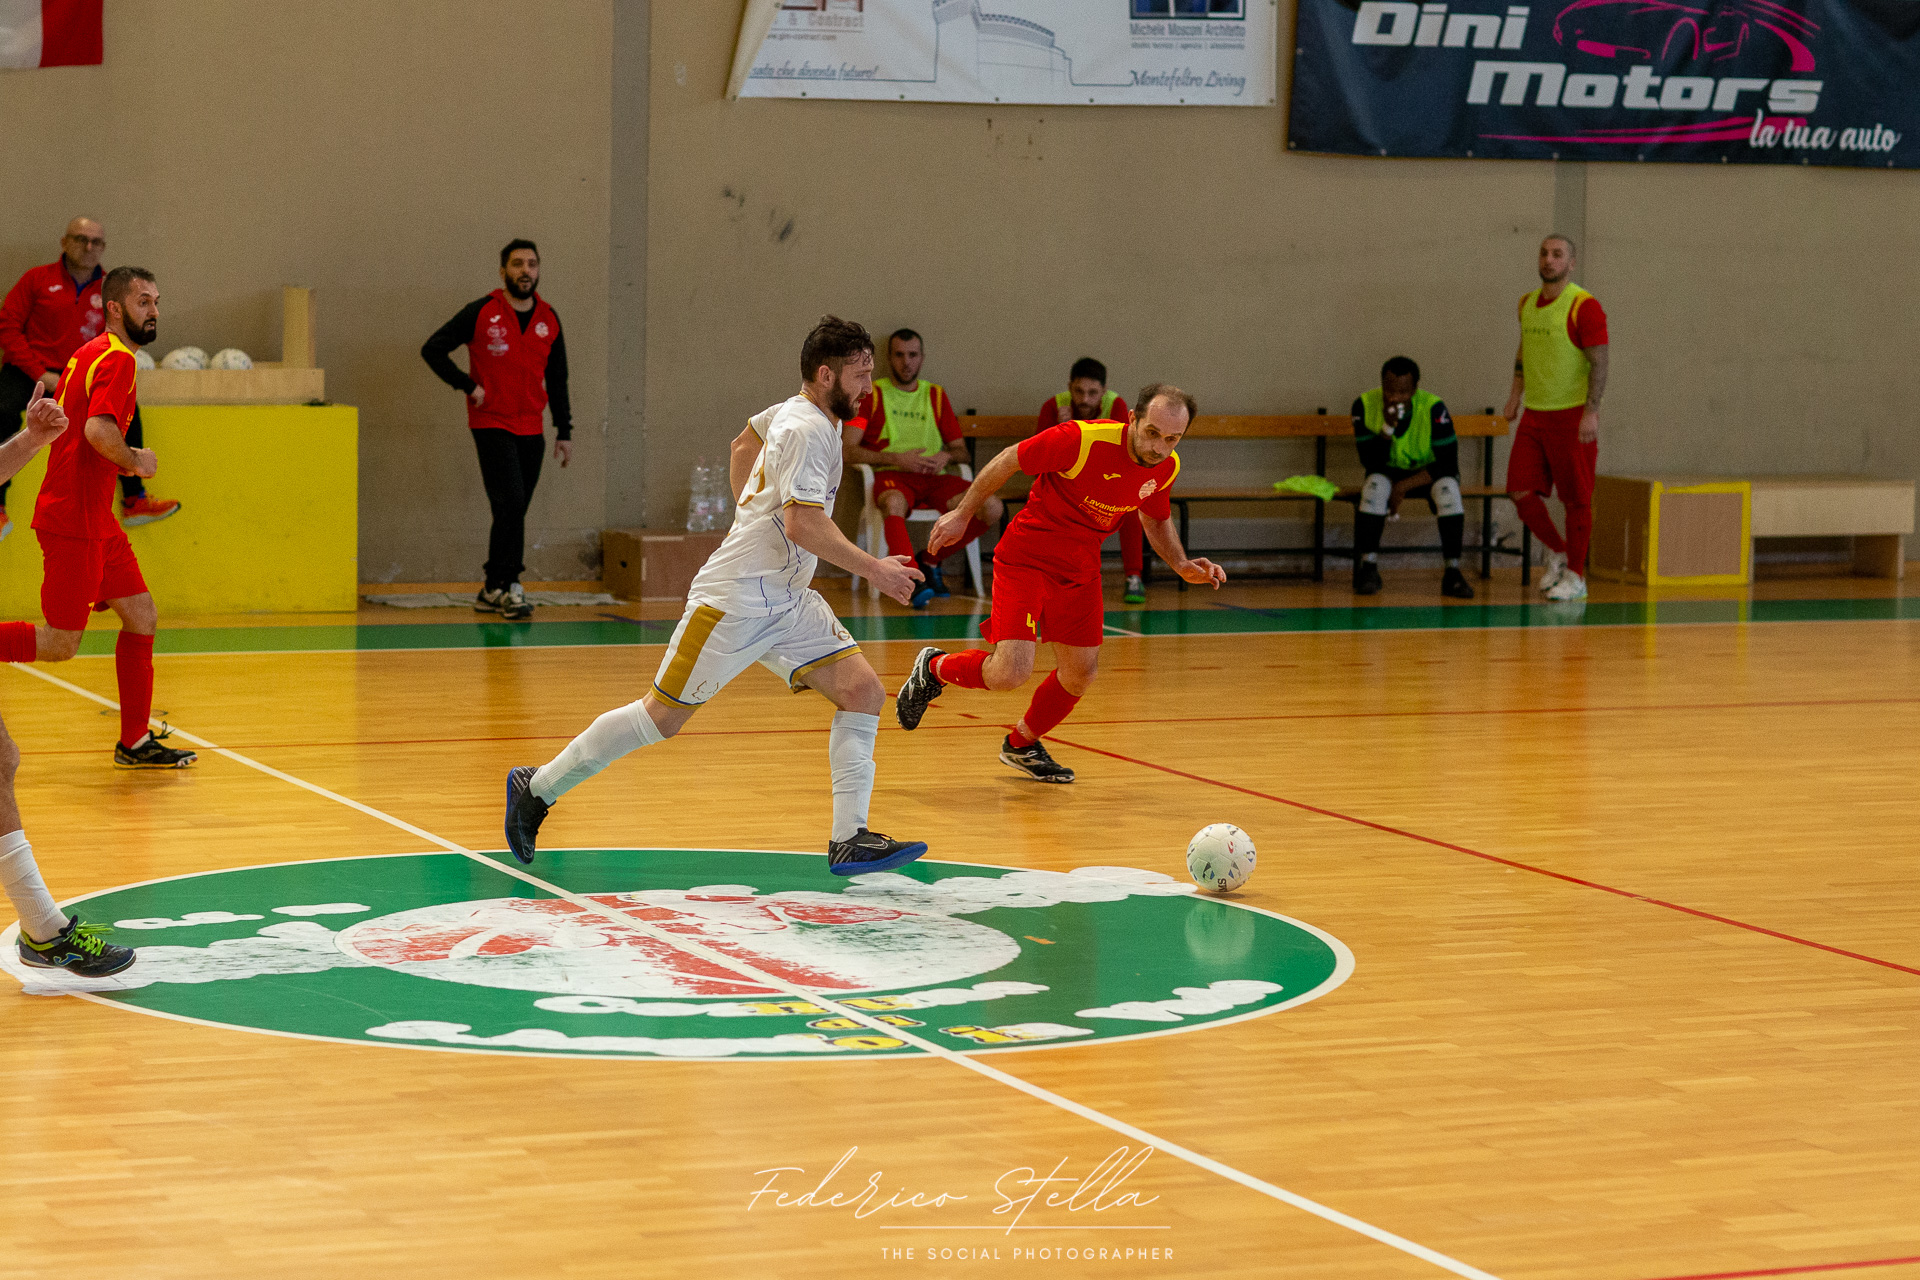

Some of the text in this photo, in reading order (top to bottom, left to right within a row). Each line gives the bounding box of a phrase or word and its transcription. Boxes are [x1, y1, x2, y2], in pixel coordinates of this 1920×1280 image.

[807, 12, 864, 28] Contract
[1130, 23, 1165, 36] Michele
[1168, 23, 1203, 36] Mosconi
[1352, 1, 1530, 50] Dini
[1466, 60, 1823, 113] Motors
[1749, 108, 1901, 153] la tua auto
[1026, 612, 1036, 635] 4
